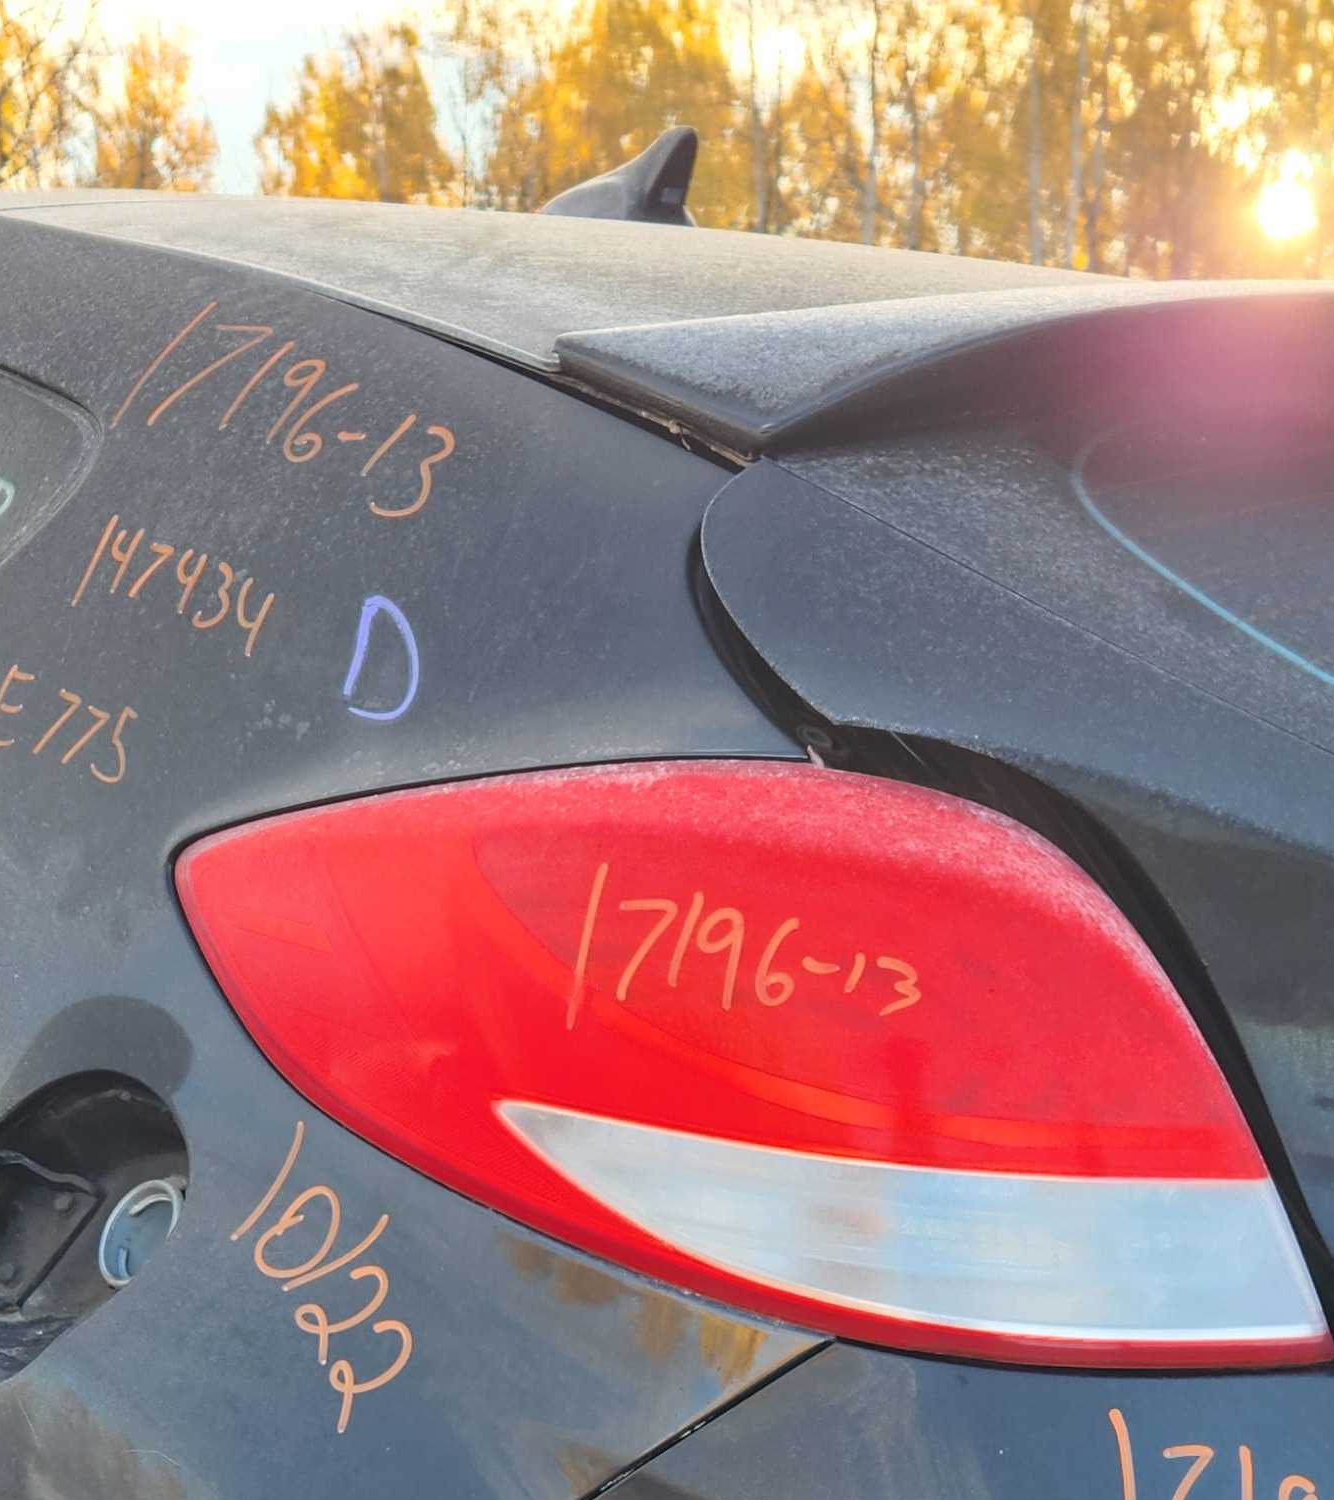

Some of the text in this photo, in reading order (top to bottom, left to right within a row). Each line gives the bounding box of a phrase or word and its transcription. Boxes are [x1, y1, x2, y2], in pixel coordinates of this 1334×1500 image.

[110, 300, 455, 519] 17196-13
[71, 514, 274, 657] 147434
[342, 595, 419, 720] D
[566, 863, 923, 1030] 17196-13
